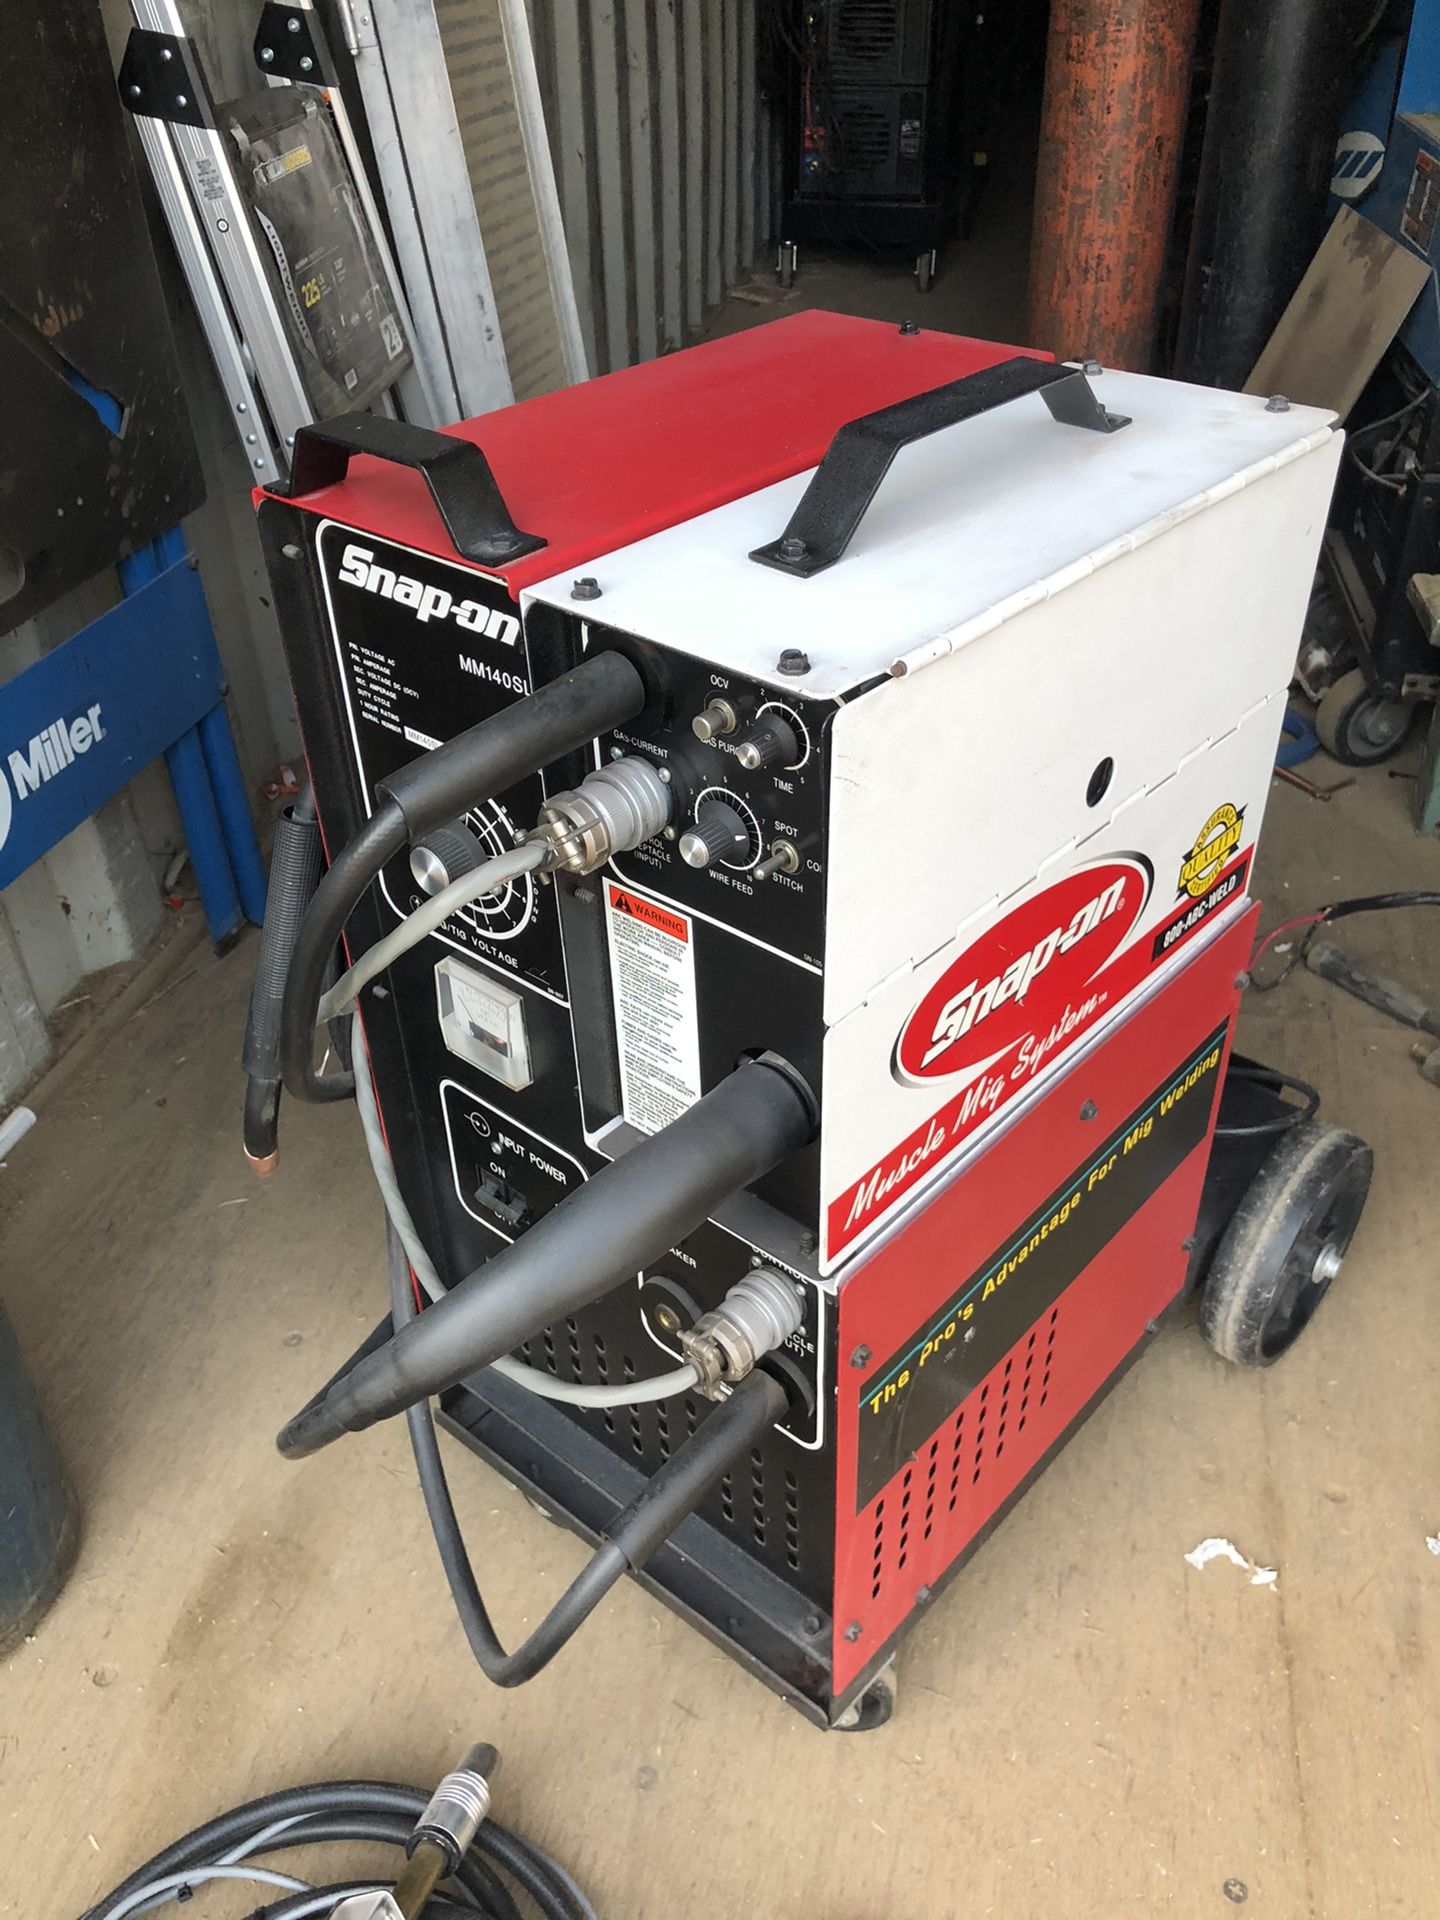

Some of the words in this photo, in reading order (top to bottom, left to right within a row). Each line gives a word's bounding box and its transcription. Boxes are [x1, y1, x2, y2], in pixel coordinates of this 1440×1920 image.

[265, 223, 310, 338] LIGHTWEIGHT
[301, 277, 321, 308] 225
[338, 544, 521, 646] Snap-on
[360, 646, 386, 663] VOLTAGE
[363, 658, 391, 676] AMPERAGE
[366, 670, 392, 687] VOLTAGE
[369, 682, 398, 700] AMPERAGE
[710, 674, 729, 690] OCV
[373, 695, 391, 708] CYCLE
[7, 702, 103, 800] Miller
[613, 728, 669, 759] GAS-CURRENT
[773, 777, 794, 795] TIME
[774, 820, 798, 838] SPOT
[638, 843, 672, 864] EPTACLE
[1182, 826, 1237, 882] QUALITY
[806, 859, 822, 873] CO
[708, 868, 730, 886] WIRE
[731, 878, 754, 896] FEED
[772, 872, 804, 893] STITCH
[633, 902, 684, 934] WARNING
[1163, 874, 1237, 949] 800-ABC-WELD
[440, 920, 468, 941] G/TIG
[471, 935, 519, 969] VOLTAGE
[498, 1132, 526, 1158] INPUT
[529, 1151, 567, 1186] POWER
[843, 1118, 945, 1231] Muscle
[952, 1075, 1006, 1135] Mig
[489, 1161, 506, 1179] ON
[869, 1369, 910, 1415] The
[918, 1302, 974, 1367] Pro's
[981, 1191, 1081, 1301] Advantage
[1087, 1154, 1118, 1192] For
[1122, 1117, 1153, 1155] Mig
[1159, 1047, 1220, 1116] Welding
[669, 1248, 697, 1269] AKER
